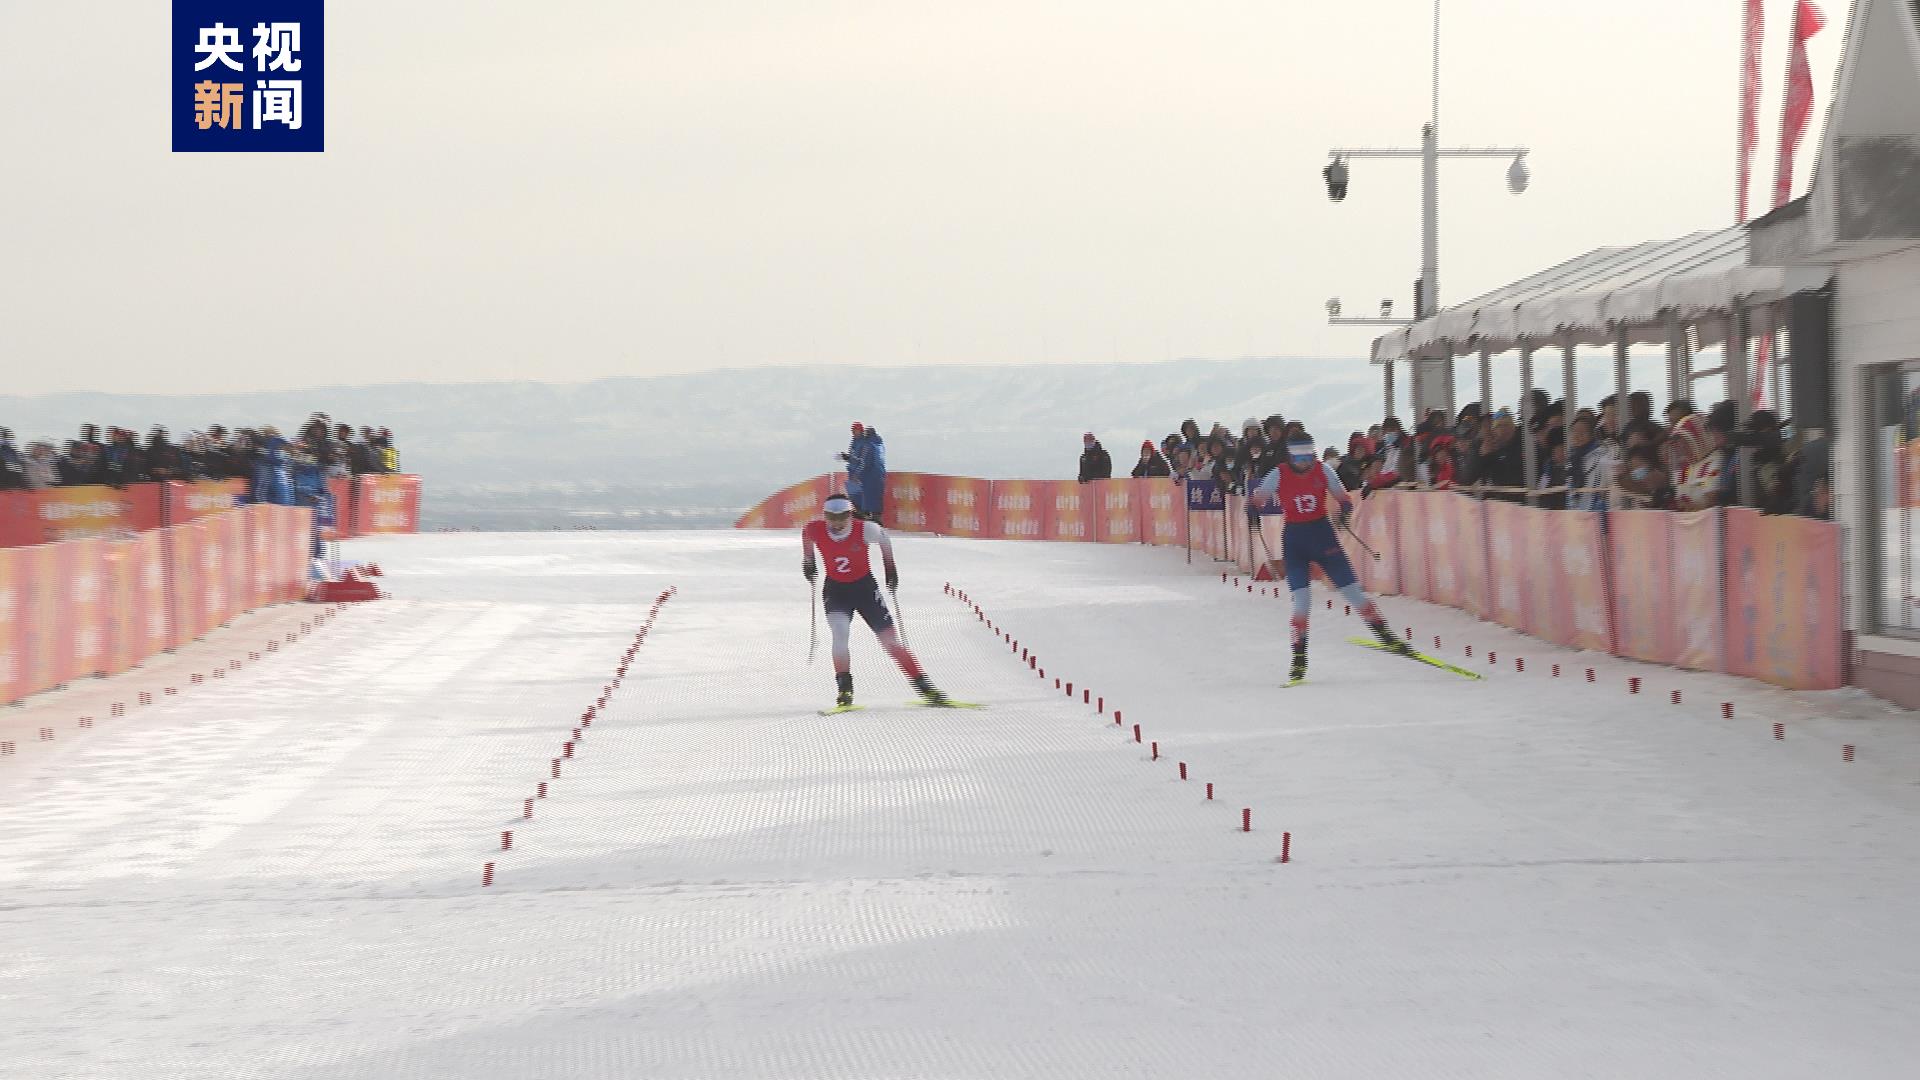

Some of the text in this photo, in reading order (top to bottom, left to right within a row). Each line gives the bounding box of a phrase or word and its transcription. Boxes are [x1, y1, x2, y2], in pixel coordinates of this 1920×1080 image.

[1190, 487, 1222, 504] 终点
[1294, 494, 1317, 514] 13
[834, 557, 851, 573] 2
